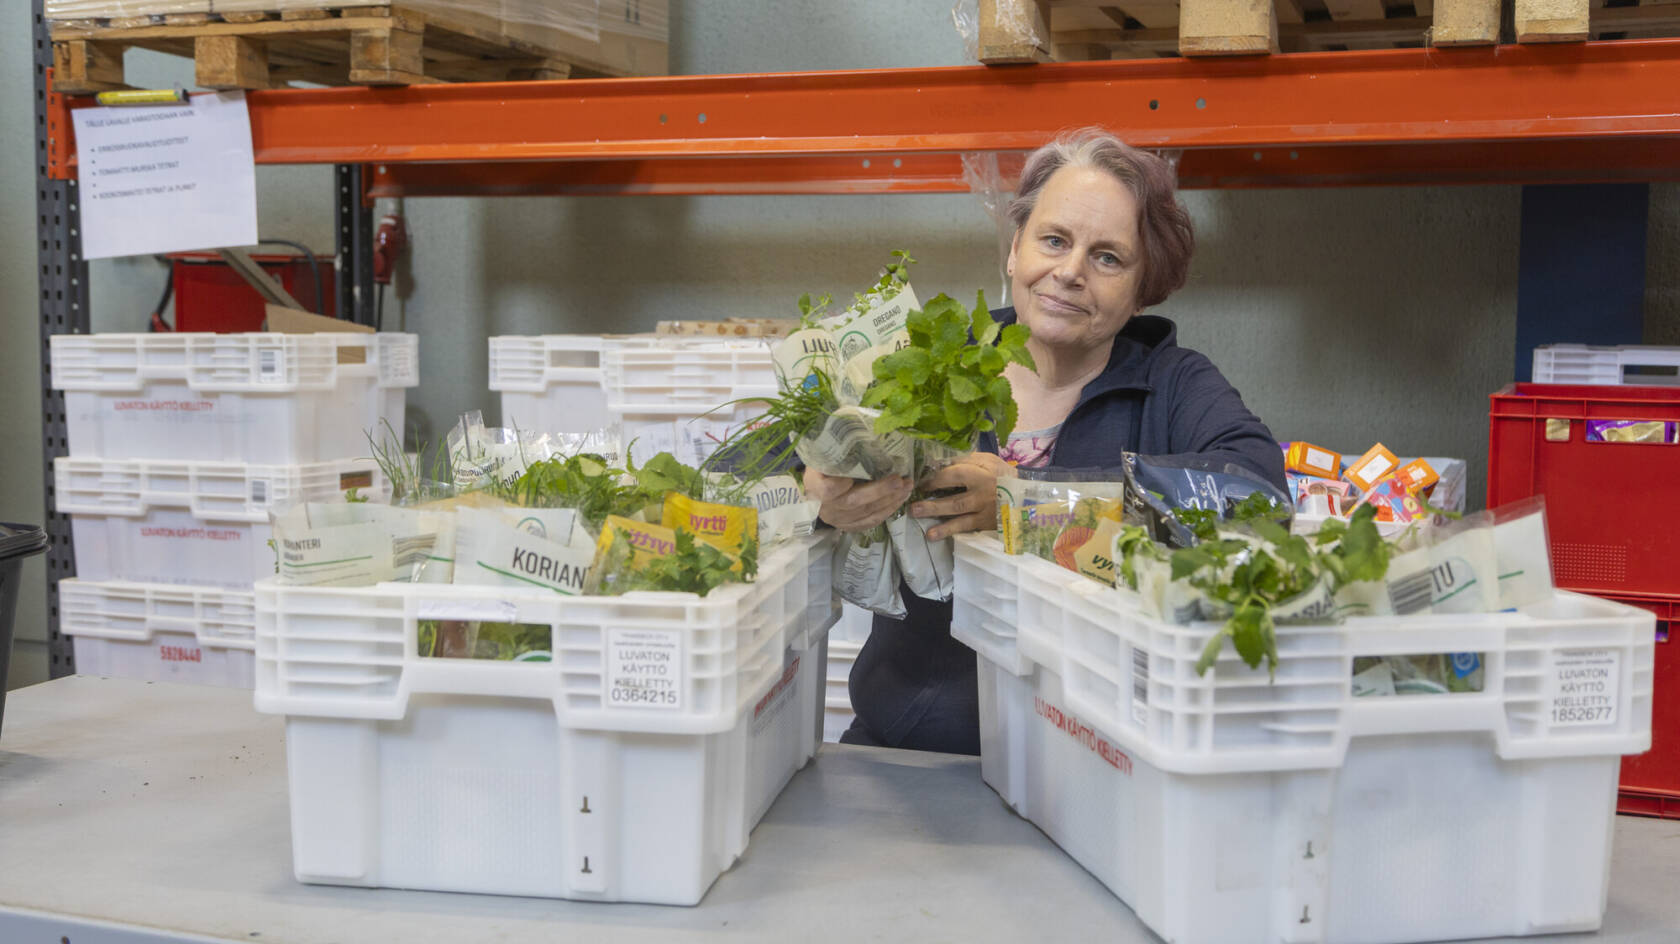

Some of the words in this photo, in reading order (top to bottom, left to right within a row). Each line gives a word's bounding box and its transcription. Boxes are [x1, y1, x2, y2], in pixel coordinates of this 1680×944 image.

[619, 650, 670, 662] LUVATON
[622, 663, 668, 676] KÄYTTÖ
[1559, 668, 1609, 681] LUVATON
[614, 678, 674, 689] KIELLETTY
[1561, 680, 1606, 693] KÄYTTÖ
[611, 687, 678, 704] 0364215
[1553, 695, 1609, 707] KIELLETTY
[1551, 706, 1613, 723] 1852677
[1034, 695, 1067, 733] LUVATON
[1066, 716, 1097, 752] KÄYTTÖ
[1096, 737, 1133, 777] KIELLETTY
